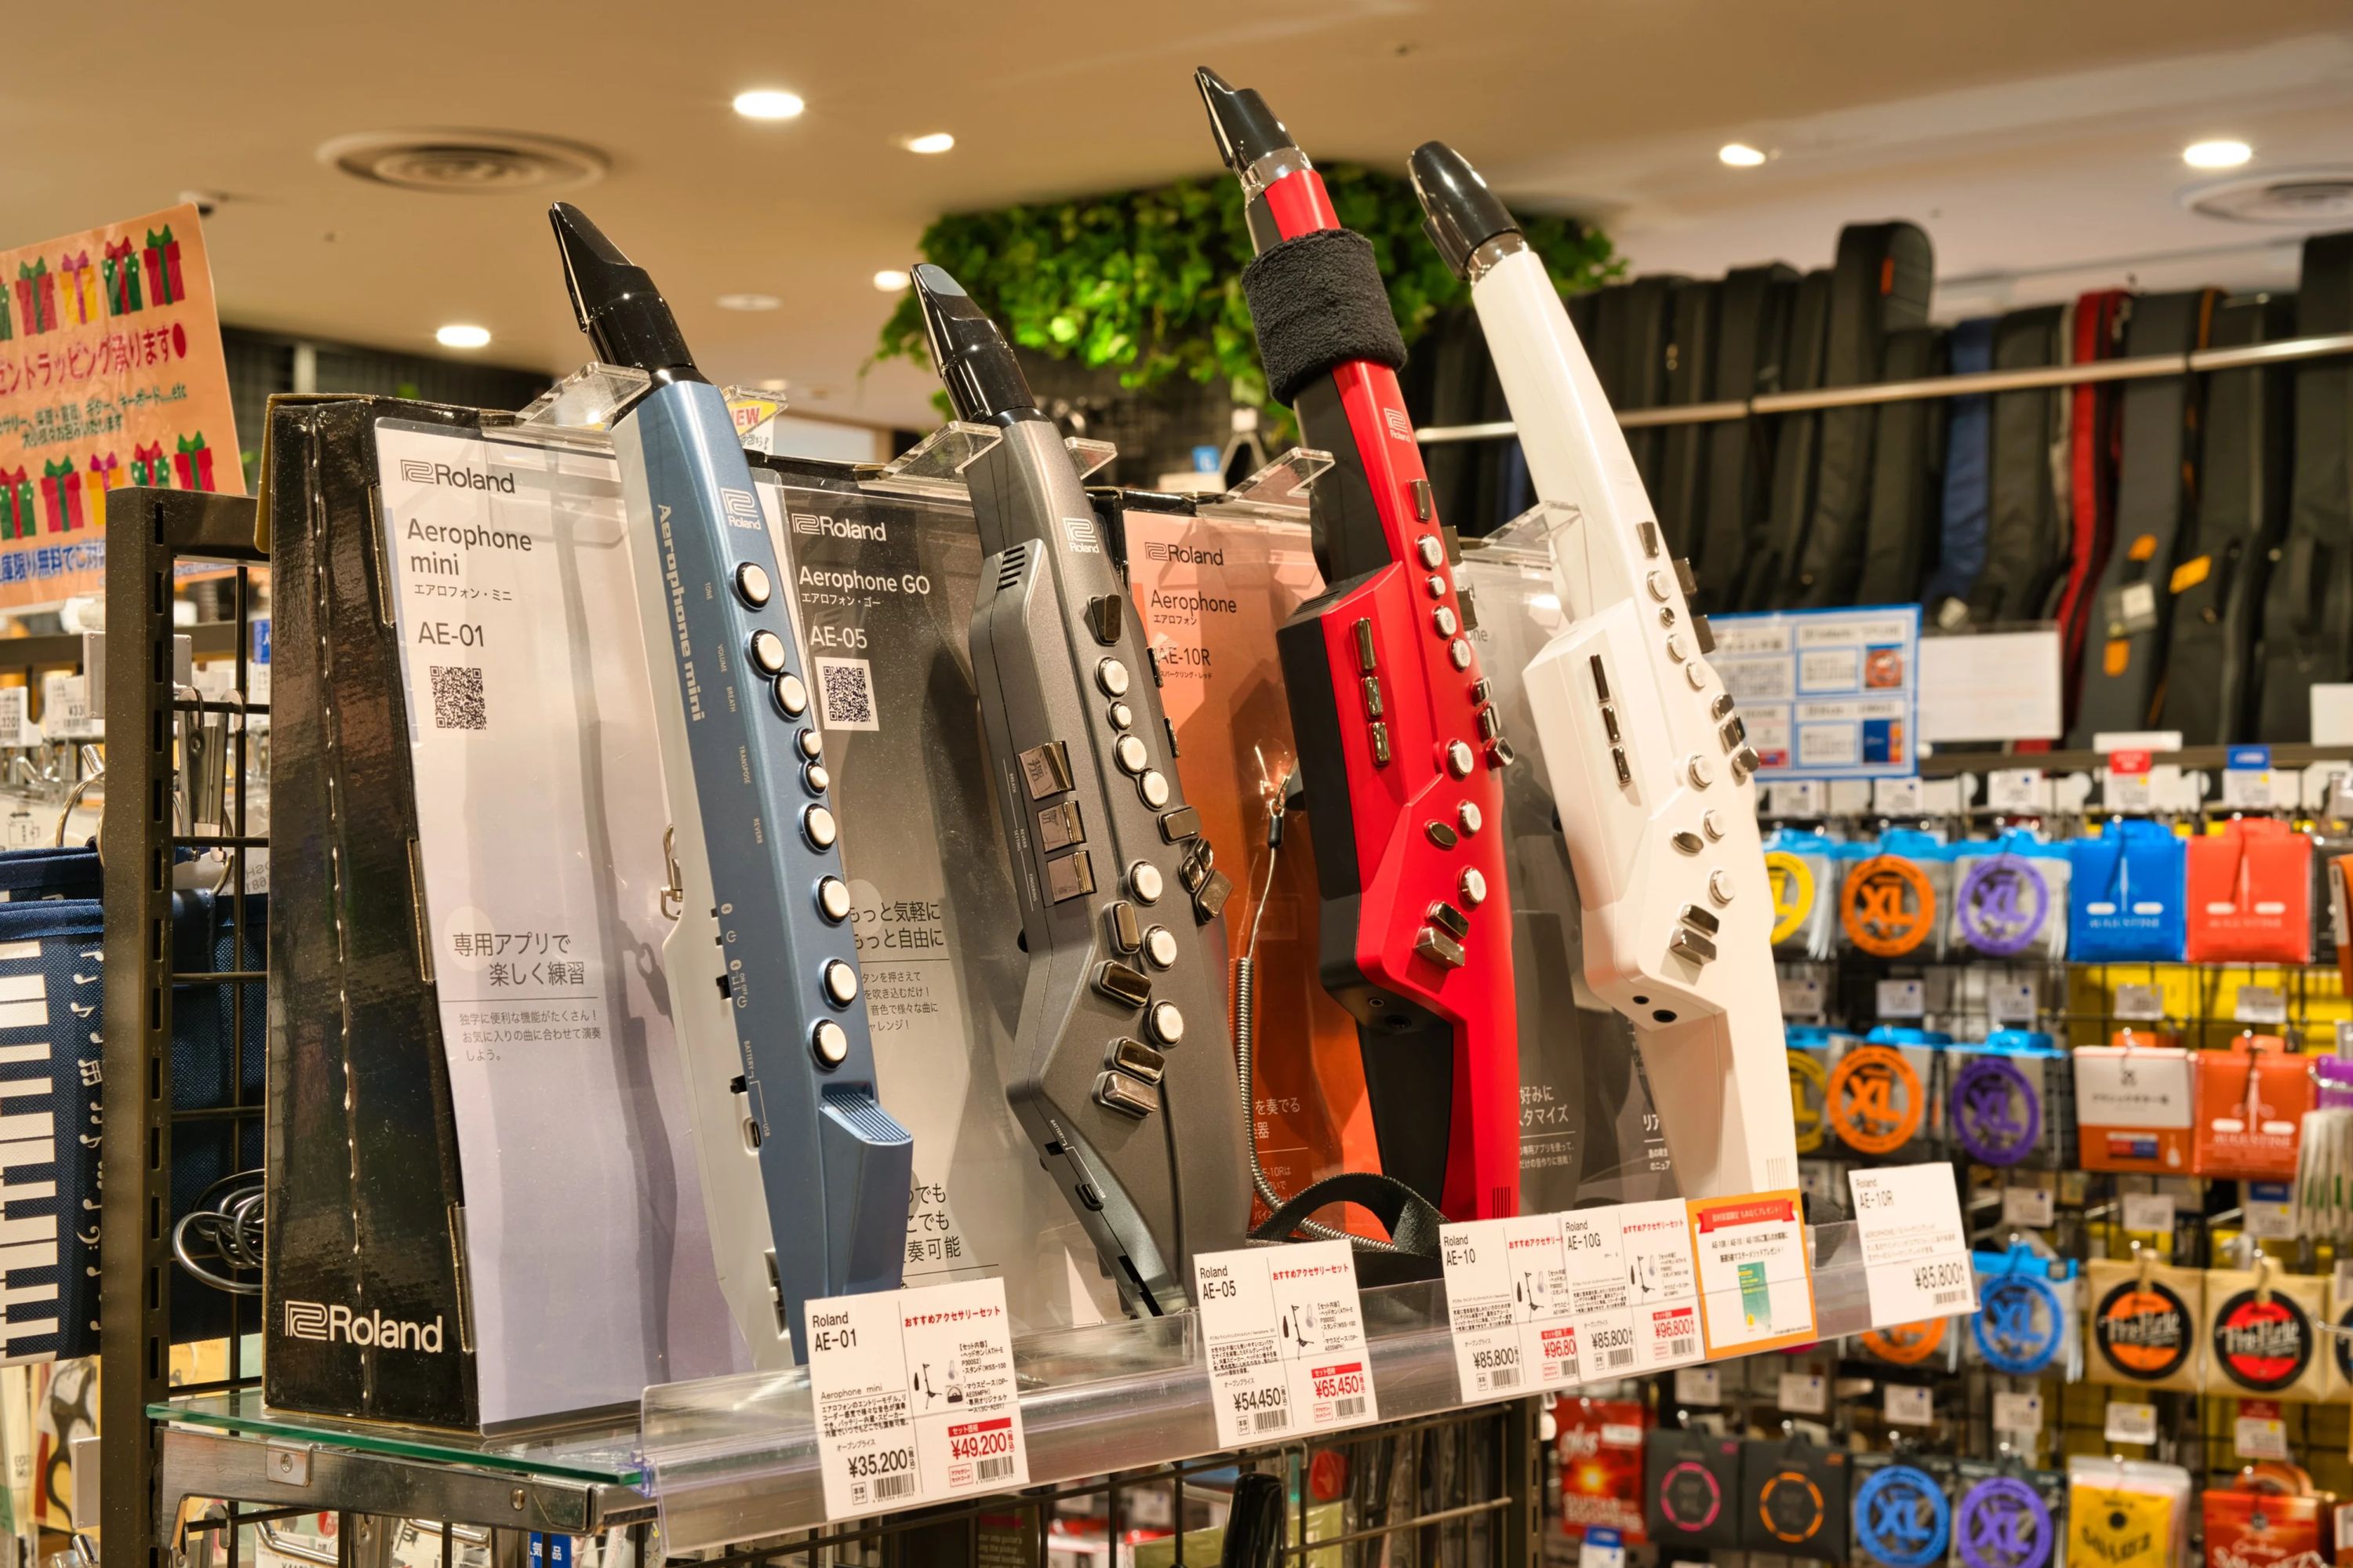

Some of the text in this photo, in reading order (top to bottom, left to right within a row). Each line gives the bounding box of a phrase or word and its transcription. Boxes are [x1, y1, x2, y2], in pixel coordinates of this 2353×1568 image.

[732, 407, 760, 426] EW
[435, 463, 515, 493] Roland
[729, 515, 762, 530] Roland
[820, 515, 887, 541] Roland
[407, 518, 533, 551] Aerophone
[1070, 541, 1100, 554] Roland
[1168, 544, 1224, 566] Roland
[410, 551, 460, 576] mini
[798, 565, 931, 595] Aerophone GO
[414, 584, 513, 602] エアロフォン・ミニ
[802, 593, 882, 608] エアロフォン・ゴー
[1151, 589, 1238, 615] Aerophone
[658, 504, 705, 722] Aerophone mini
[1153, 614, 1198, 626] エアロフォン
[418, 620, 485, 648] AE-01
[809, 624, 868, 649] AE-05
[717, 644, 728, 673] VOLUME
[1158, 647, 1212, 666] AE-10R
[726, 686, 736, 713] BREATH
[738, 745, 751, 784] TRANSPOSE
[753, 817, 763, 845] REVERB
[453, 931, 571, 957] 専用アプリで
[489, 961, 585, 987] 楽しく練習
[459, 1010, 597, 1026] 独学に便利な機能がたくさん！
[871, 1002, 939, 1017] 音色で様々な曲に
[462, 1027, 602, 1044] お気に入りの曲に合わせて演奏
[465, 1049, 501, 1062] しよう。
[744, 1040, 755, 1071] BATTERY
[762, 1122, 771, 1137] USB
[1049, 1119, 1065, 1140] BATTERY
[1254, 1121, 1270, 1139] 器
[1097, 1188, 1107, 1199] USB
[1856, 1177, 1878, 1188] Roland
[1860, 1189, 1895, 1210] AE-10R
[1566, 1219, 1588, 1232] Roland
[904, 1235, 962, 1264] 奏可能
[1444, 1234, 1469, 1247] Roland
[1568, 1232, 1602, 1252] AE-10G
[1446, 1248, 1476, 1267] AE-10
[1200, 1264, 1228, 1279] Roland
[1273, 1263, 1349, 1281] おすすめアクセサリーセット
[1913, 1261, 1961, 1290] ¥85,800
[1202, 1280, 1237, 1301] AE-05
[812, 1312, 849, 1329] Roland
[904, 1305, 1002, 1328] おすすめアクセサリーセット
[329, 1304, 443, 1354] Roland
[1591, 1328, 1629, 1350] ¥85,800
[1654, 1317, 1691, 1339] ¥96,800
[814, 1328, 858, 1352] AE-01
[1473, 1347, 1515, 1370] ¥85,800
[820, 1383, 883, 1401] Aerophone mini
[1314, 1375, 1359, 1399] ¥65,450
[1233, 1387, 1282, 1412] ¥54,450
[951, 1432, 1007, 1461] ¥49,200
[847, 1448, 908, 1479] ¥35,200
